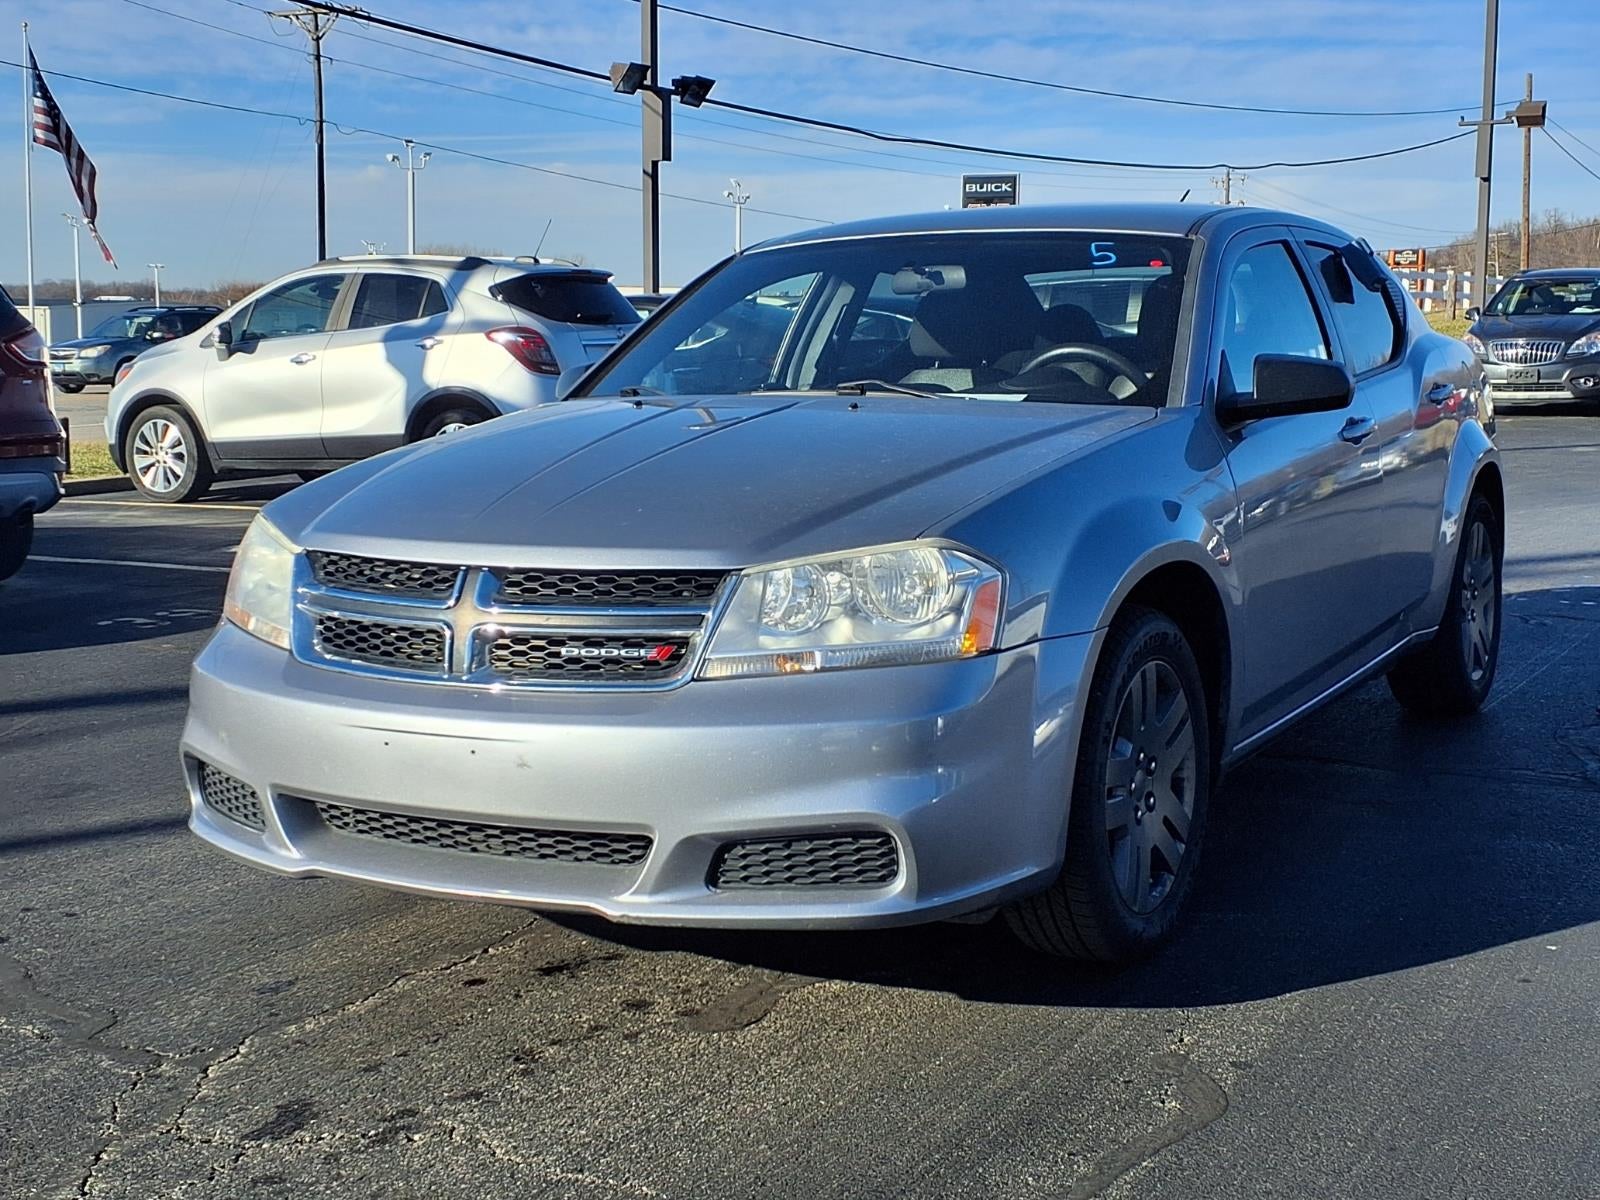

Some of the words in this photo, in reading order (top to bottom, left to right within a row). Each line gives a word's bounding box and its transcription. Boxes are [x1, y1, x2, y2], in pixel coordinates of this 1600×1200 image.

[965, 183, 1012, 192] BUICK
[1091, 242, 1117, 266] 5
[560, 647, 658, 657] DODGE
